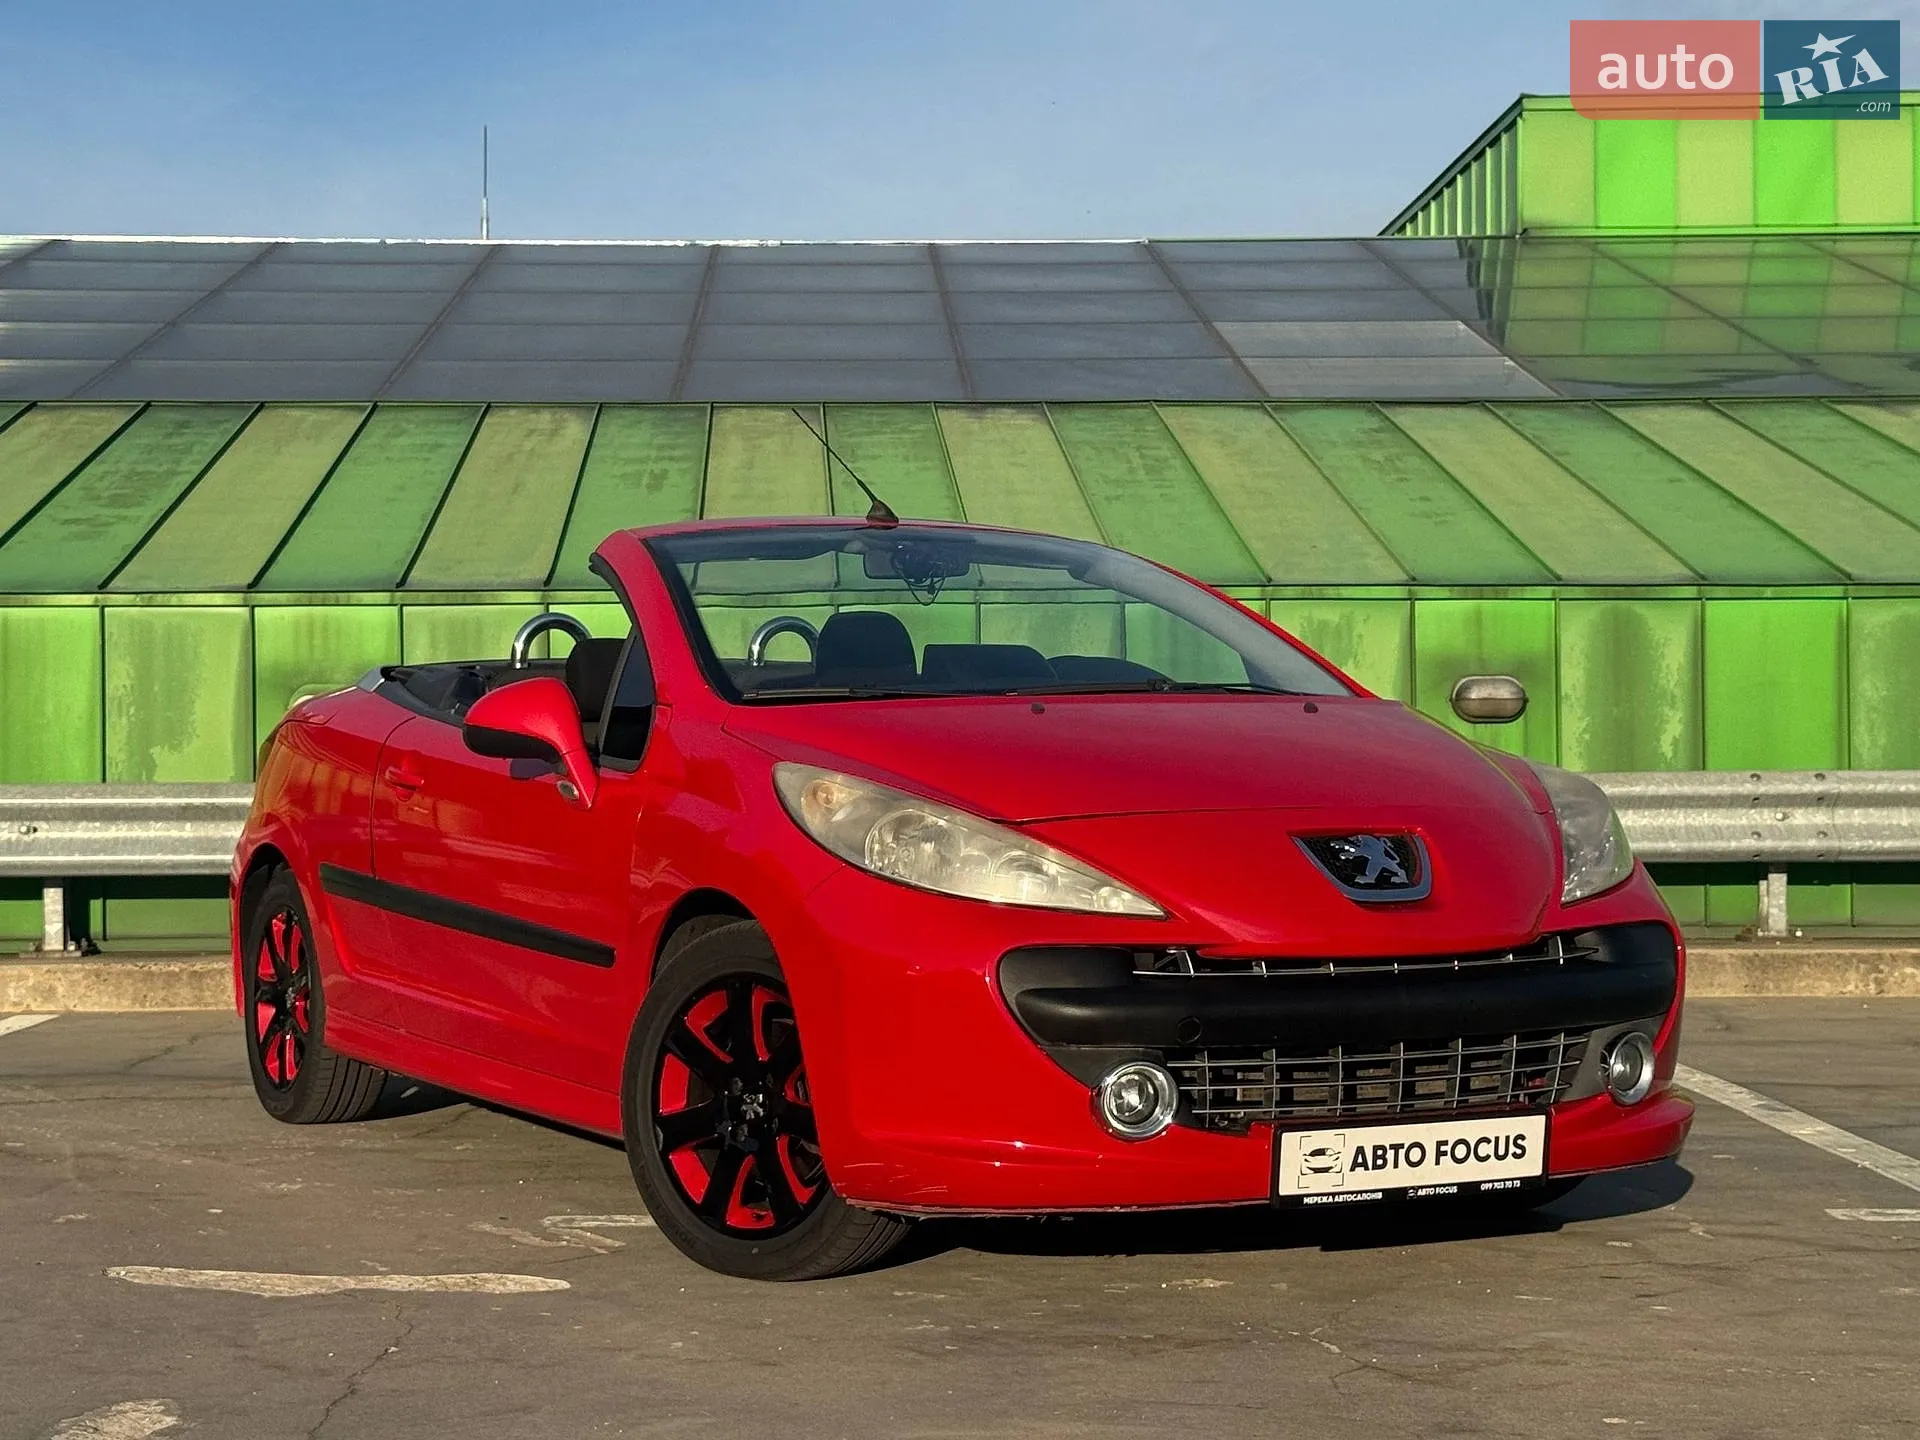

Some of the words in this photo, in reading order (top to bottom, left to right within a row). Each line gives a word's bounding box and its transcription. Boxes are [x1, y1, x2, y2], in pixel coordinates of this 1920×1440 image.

[1349, 1141, 1427, 1172] АВТО
[1434, 1133, 1527, 1166] FOCUS
[1436, 1185, 1458, 1195] FOCUS
